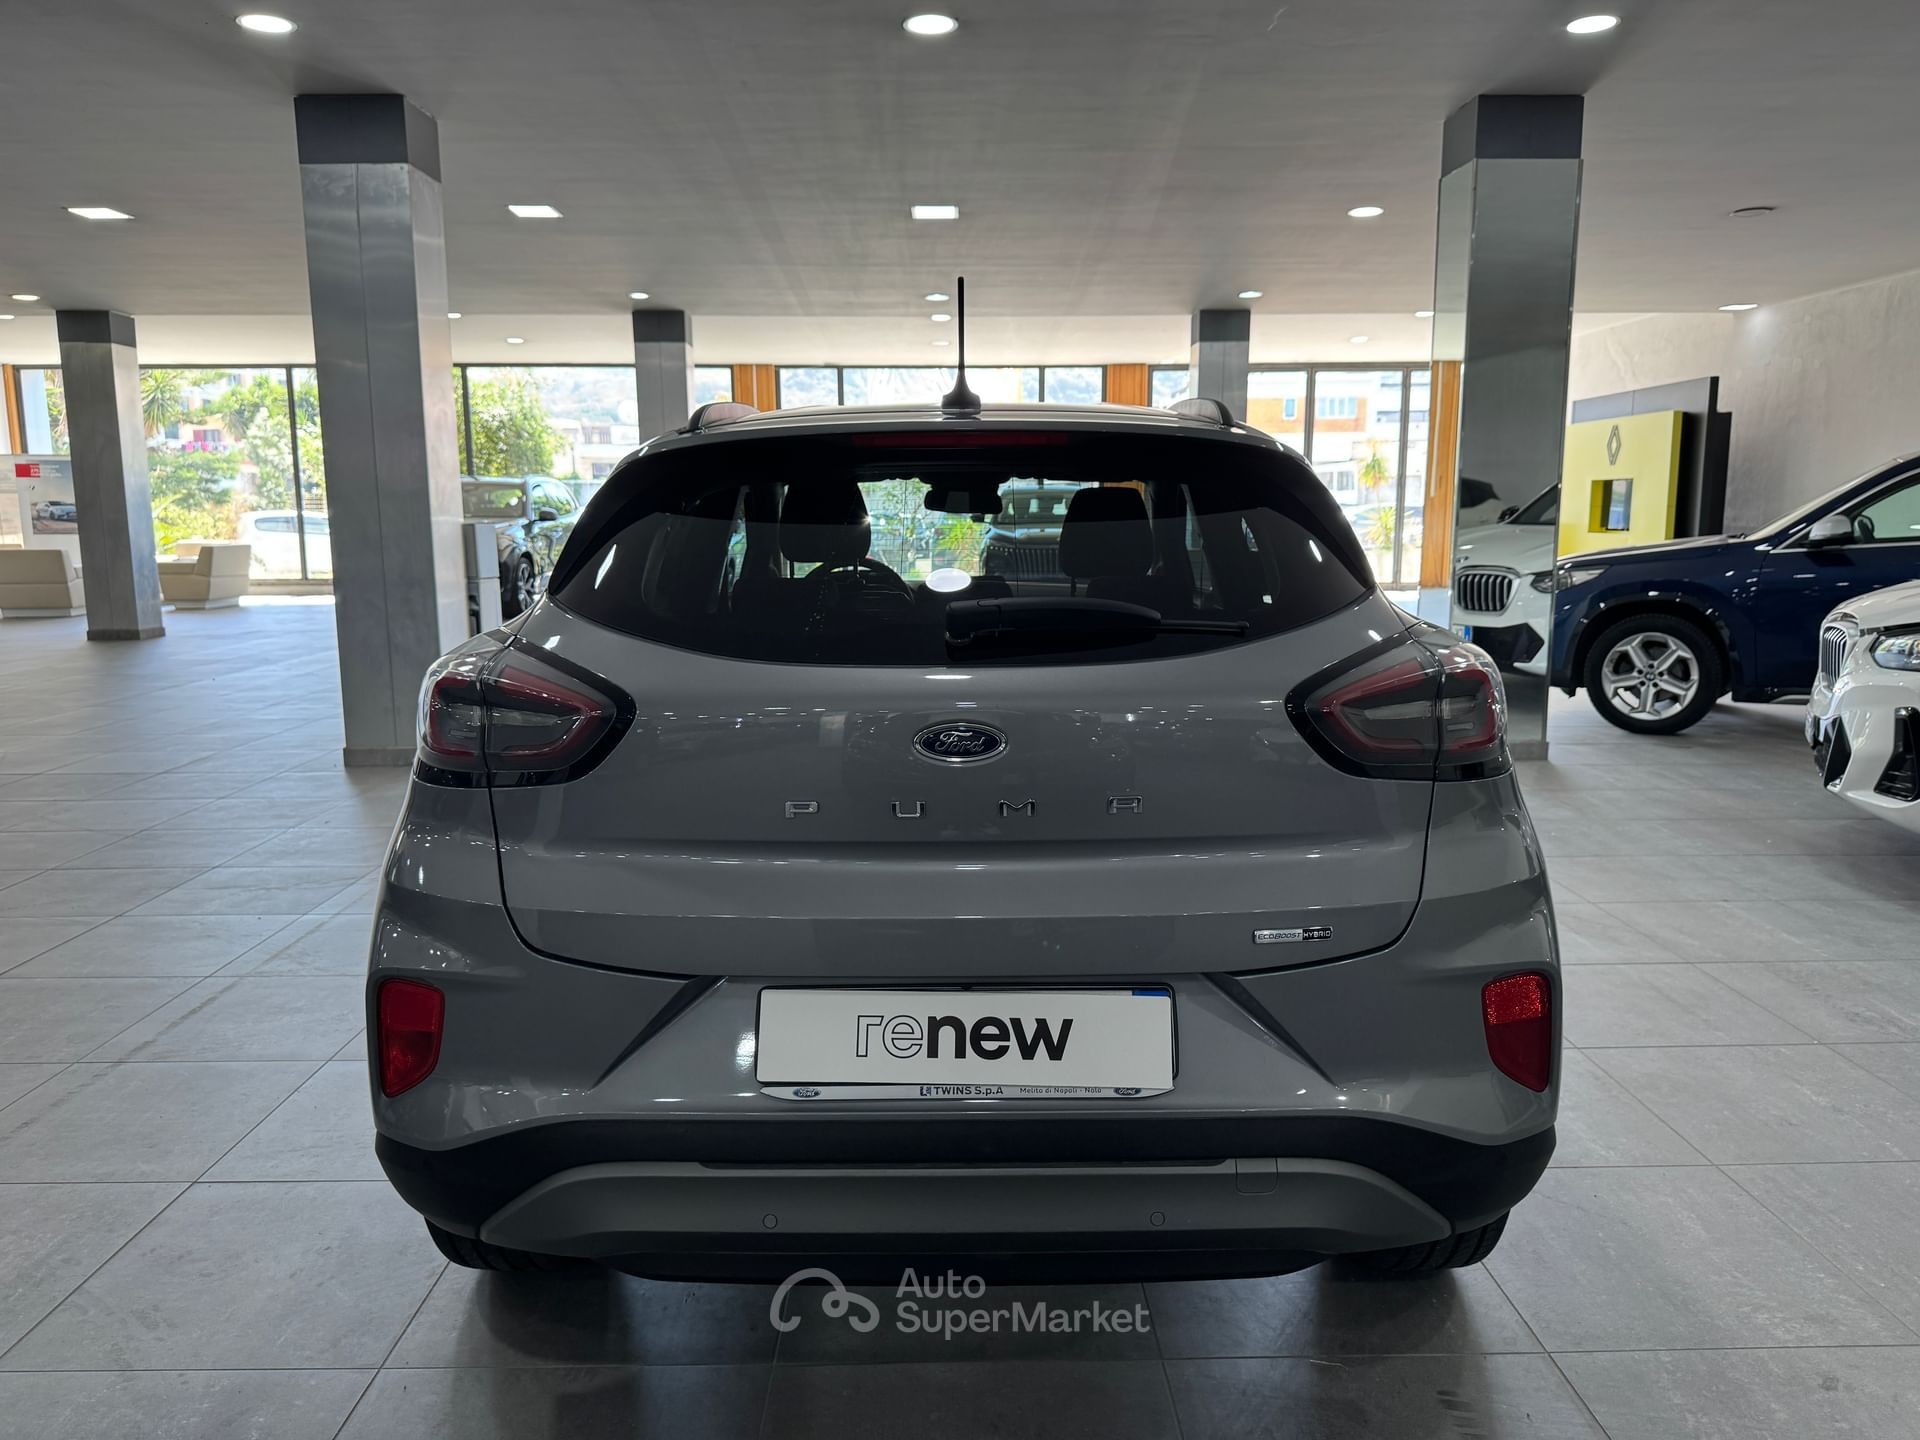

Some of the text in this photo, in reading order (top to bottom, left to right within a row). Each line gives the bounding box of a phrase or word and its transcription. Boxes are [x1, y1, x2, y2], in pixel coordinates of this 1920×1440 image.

[934, 731, 985, 753] Ford
[784, 795, 1143, 819] PUMA
[855, 1014, 1074, 1061] renew
[933, 1086, 1004, 1096] TWINS S.p.A
